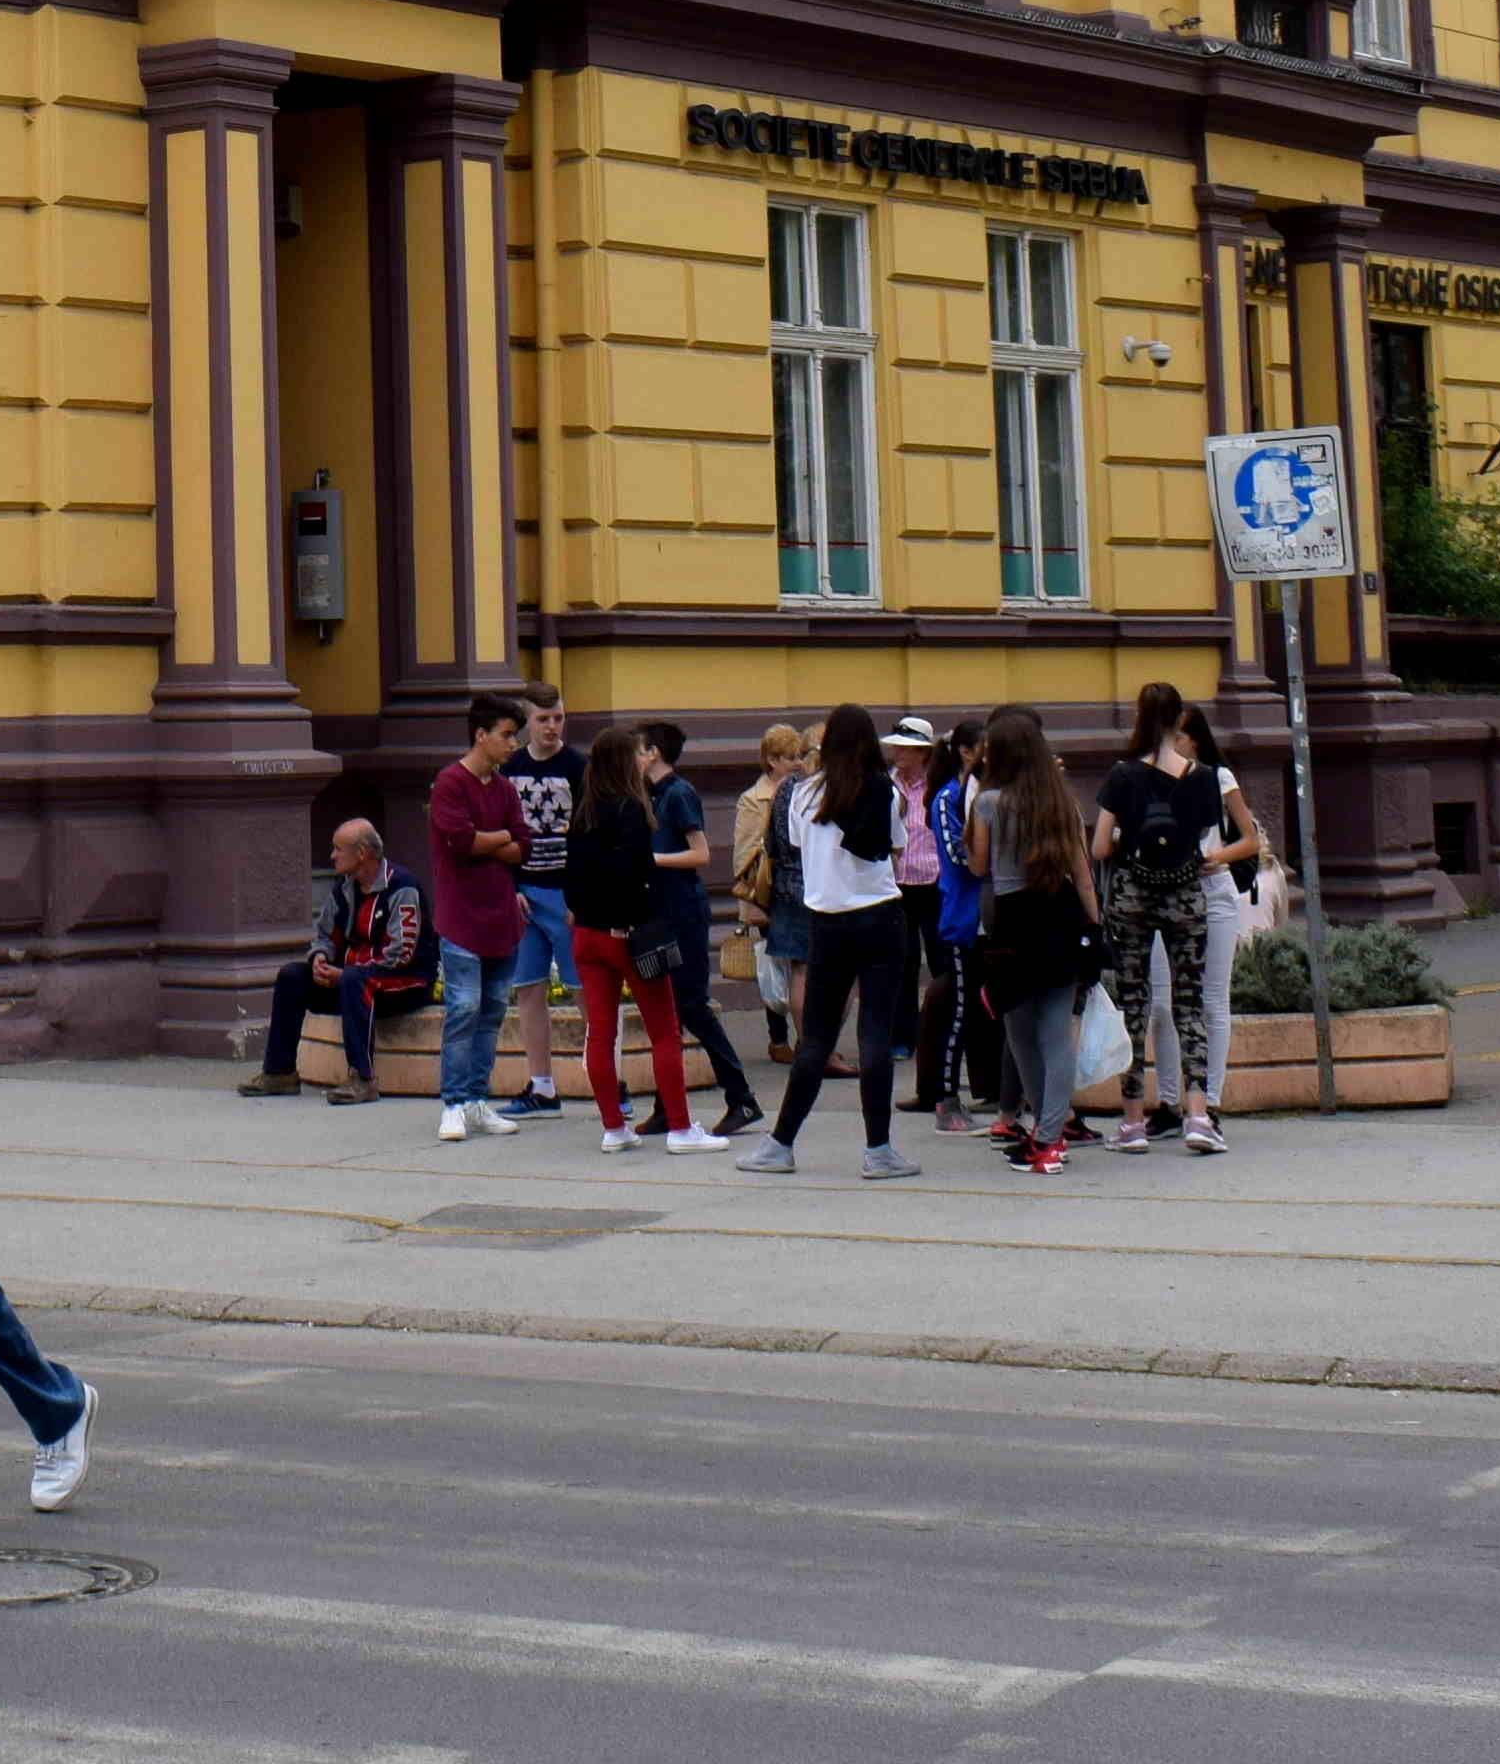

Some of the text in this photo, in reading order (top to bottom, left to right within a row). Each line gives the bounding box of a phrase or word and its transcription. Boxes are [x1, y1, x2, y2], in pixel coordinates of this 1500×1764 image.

[686, 103, 1151, 205] SOCIETE GENERALE SRBIJA
[1362, 260, 1449, 311] TISCHE
